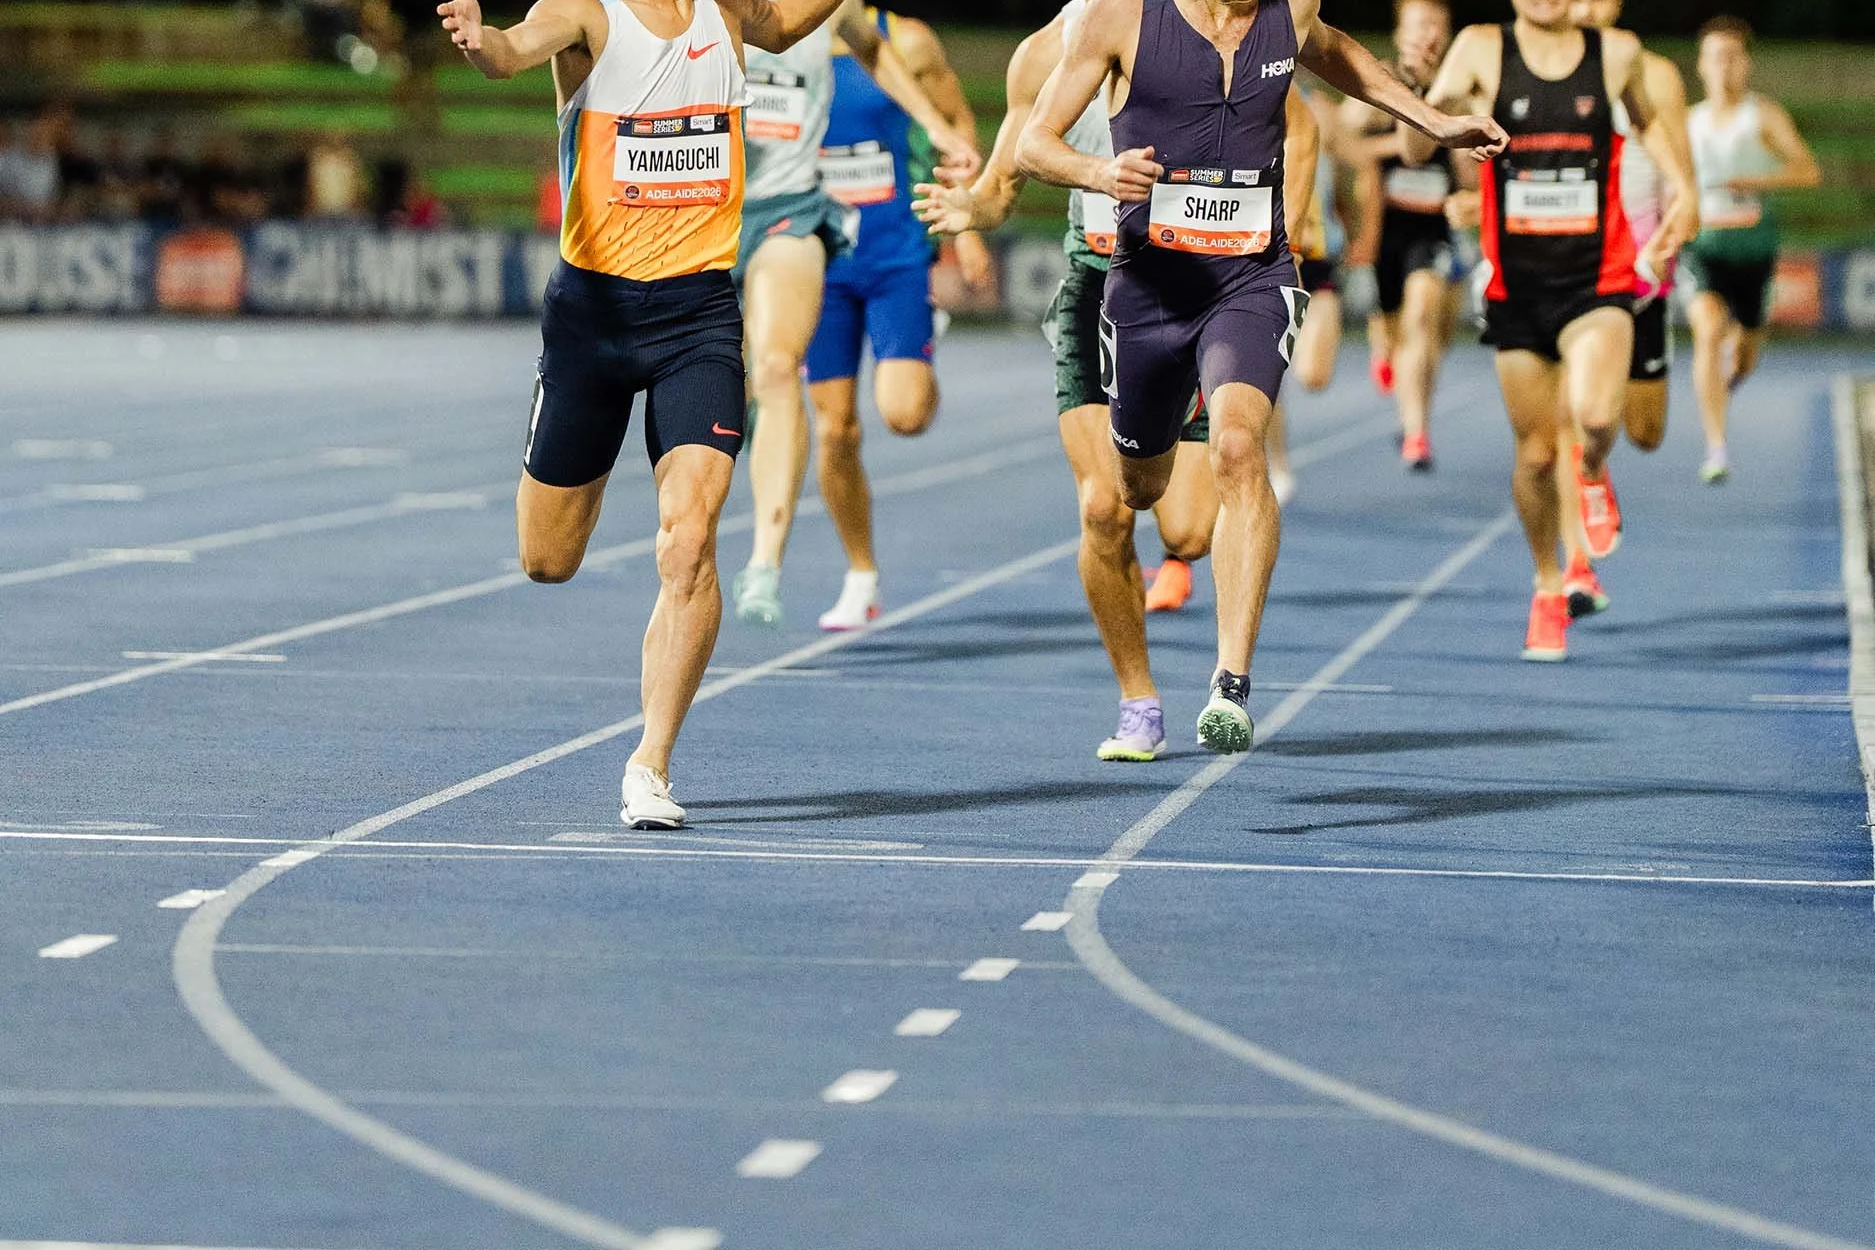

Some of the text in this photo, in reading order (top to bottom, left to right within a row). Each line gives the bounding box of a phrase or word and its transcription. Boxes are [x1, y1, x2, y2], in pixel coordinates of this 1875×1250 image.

[1261, 57, 1295, 79] HOKA
[653, 118, 683, 128] SUMMER
[692, 117, 713, 127] Smart
[653, 125, 676, 134] SERIES
[627, 146, 720, 173] YAMAGUCHI
[1189, 175, 1215, 183] SERIES
[1190, 169, 1224, 179] SUMMER
[1234, 172, 1258, 181] Smart
[645, 186, 722, 199] ADELAIDE2026
[1184, 196, 1240, 222] SHARP
[1111, 428, 1140, 449] OKA
